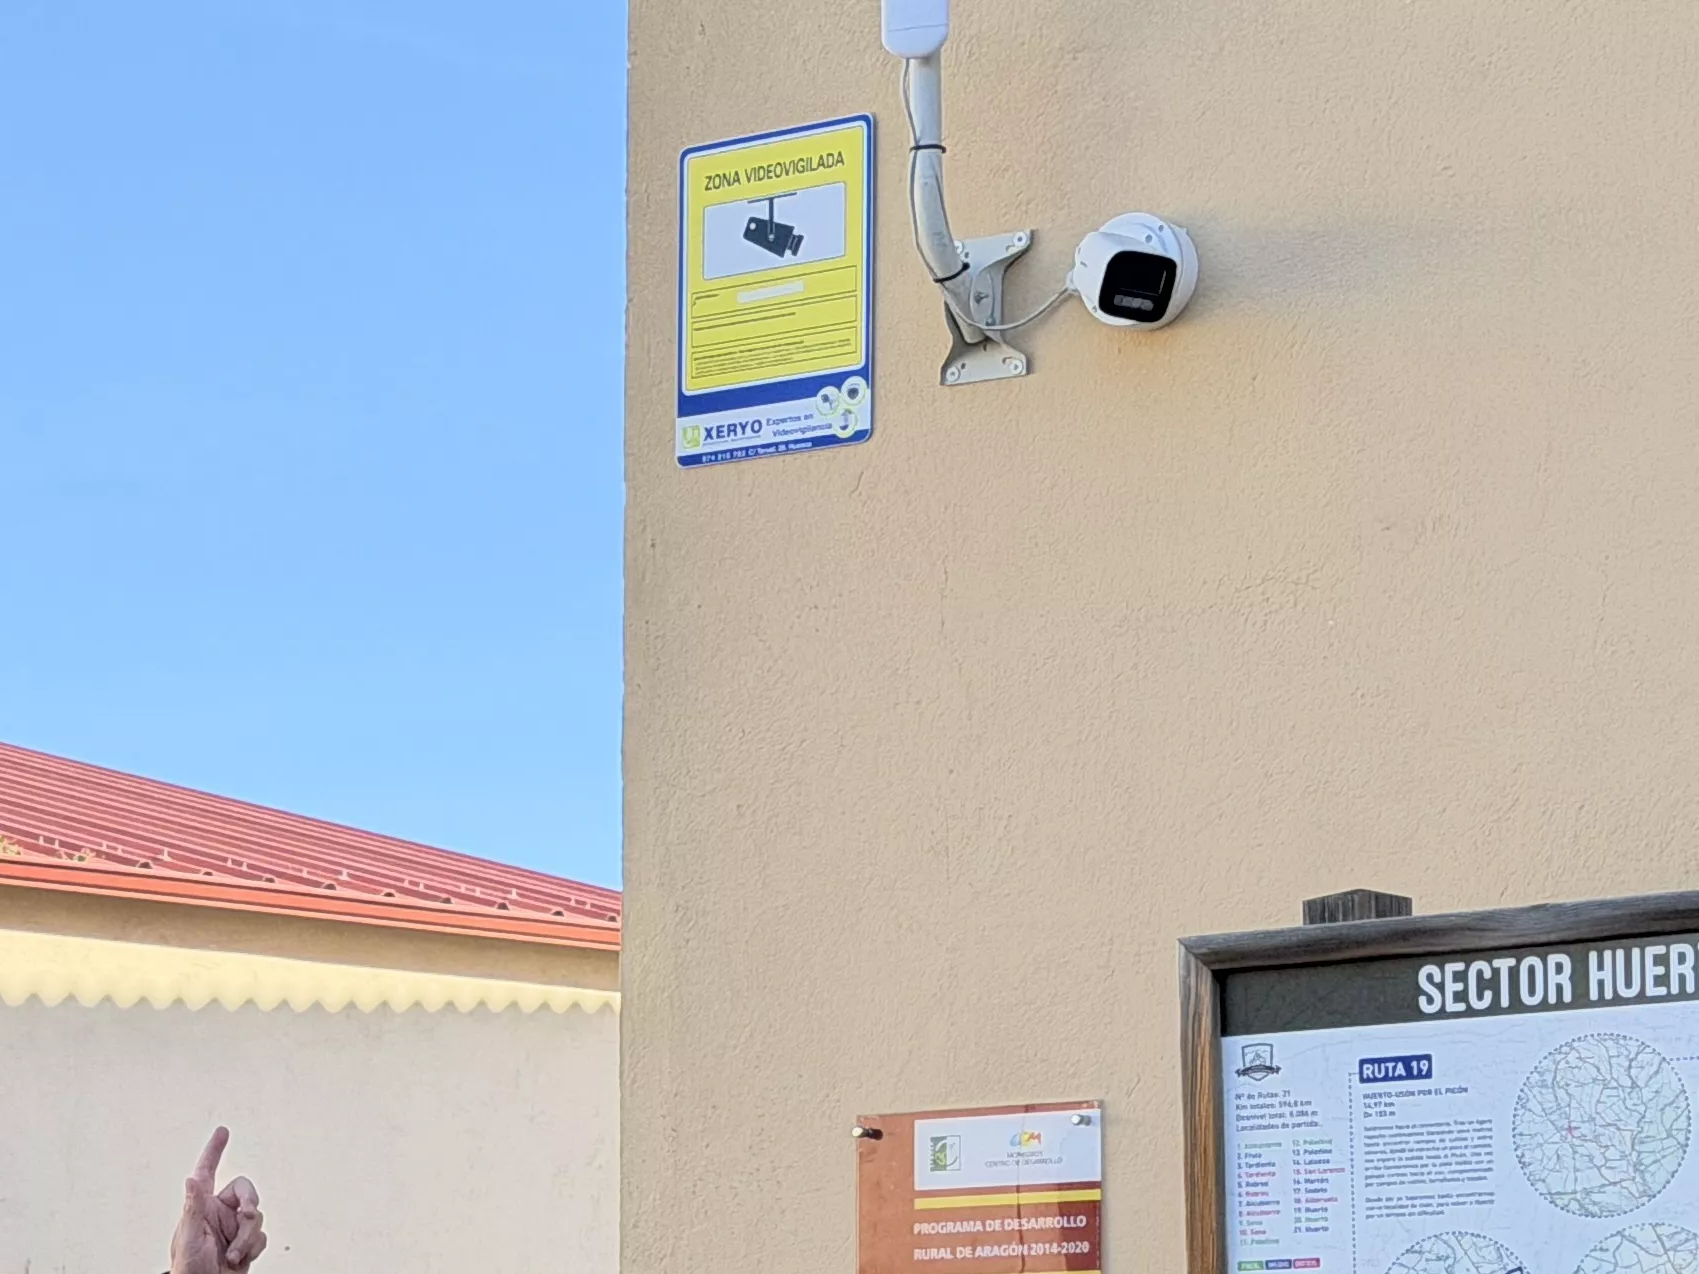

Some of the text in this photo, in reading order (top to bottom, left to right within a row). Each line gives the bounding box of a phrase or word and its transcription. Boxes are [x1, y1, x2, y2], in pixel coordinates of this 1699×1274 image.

[704, 151, 845, 191] ZONA VIDEOVIGILADA
[703, 419, 763, 441] XERYO
[1418, 943, 1699, 1014] SECTOR HUER
[1362, 1060, 1429, 1079] RUTA 19
[913, 1215, 1087, 1235] PROGRAMA DE DESARROLLO
[914, 1240, 1090, 1260] RURAL DE ARAGÓN 2014-2020
